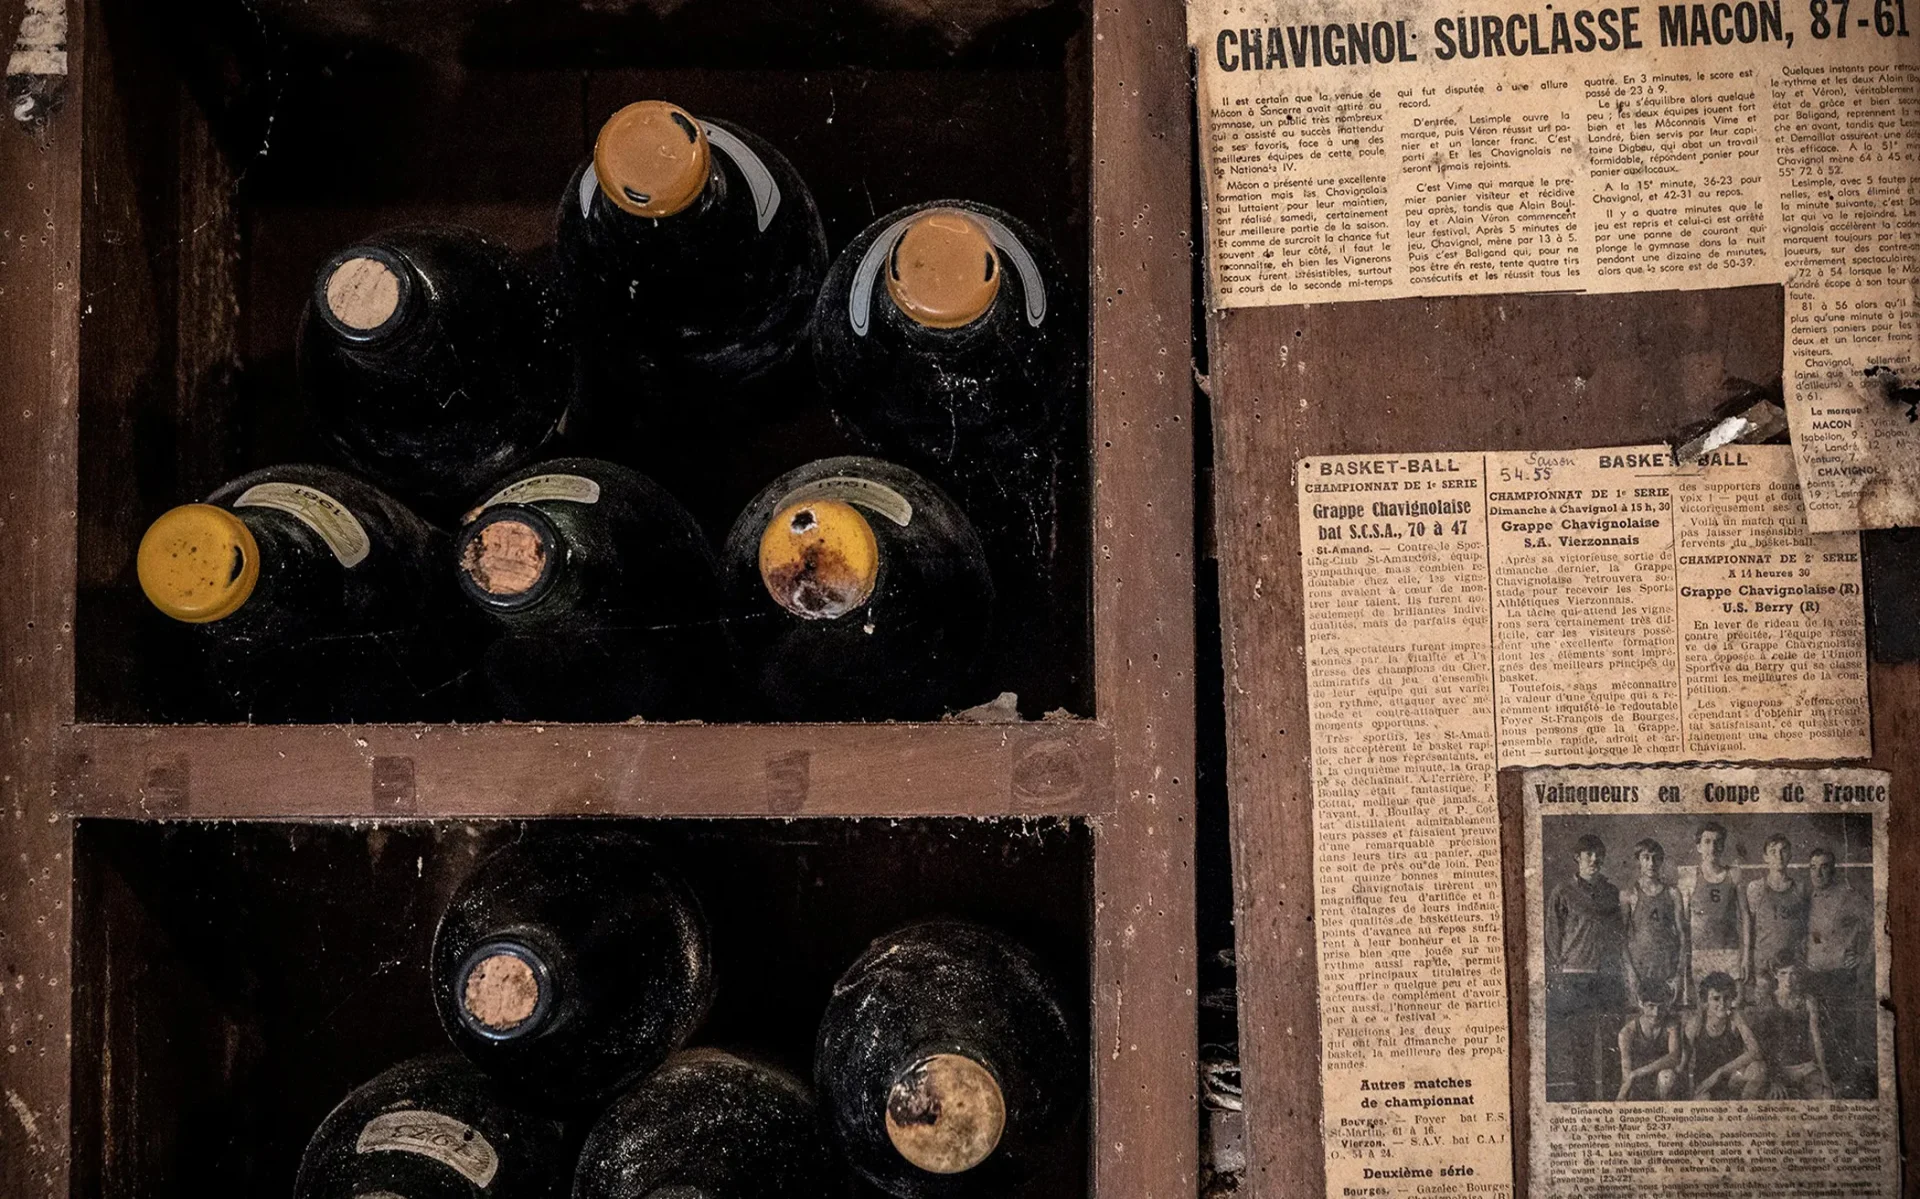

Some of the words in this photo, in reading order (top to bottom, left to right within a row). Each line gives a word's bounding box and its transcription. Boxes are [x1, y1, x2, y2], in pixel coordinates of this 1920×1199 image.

[1216, 20, 1417, 72] CHAVIGNOL
[1434, 5, 1643, 61] SURCLASSE
[1659, 0, 1794, 49] MACON,
[1624, 75, 1635, 84] En
[1641, 74, 1647, 83] 3
[1653, 73, 1692, 82] minutes,
[1697, 71, 1705, 80] le
[1710, 72, 1734, 80] score
[1740, 69, 1753, 78] est
[1782, 65, 1824, 76] Quelques
[1829, 65, 1864, 73] instants
[1869, 65, 1889, 73] pour
[1236, 97, 1249, 105] est
[1255, 93, 1288, 104] certain
[1295, 95, 1312, 103] que
[1319, 92, 1328, 100] la
[1335, 90, 1363, 100] venue
[1369, 89, 1381, 98] de
[1586, 88, 1610, 99] passé
[1615, 87, 1626, 96] de
[1630, 86, 1643, 95] 23
[1648, 85, 1653, 94] à
[1658, 85, 1668, 93] 9.
[1227, 181, 1259, 190] Mâcon
[1274, 178, 1313, 189] présenté
[1338, 175, 1386, 185] excellente
[1605, 183, 1613, 191] A
[1621, 182, 1629, 190] la
[1660, 180, 1696, 188] minute,
[1704, 176, 1733, 186] 36-23
[1741, 175, 1761, 185] pour
[1405, 196, 1426, 204] mier
[1436, 194, 1466, 204] panier
[1476, 192, 1510, 200] visiteur
[1519, 191, 1529, 199] et
[1539, 189, 1575, 198] récidive
[1593, 193, 1643, 204] Chavignol,
[1649, 193, 1658, 201] et
[1664, 190, 1692, 199] 42-31
[1716, 189, 1743, 198] repos.
[1216, 205, 1230, 215] qui
[1239, 204, 1279, 212] luttaient
[1287, 202, 1308, 211] pour
[1316, 200, 1335, 208] leur
[1343, 198, 1387, 207] maintien,
[1217, 217, 1231, 225] ont
[1241, 214, 1271, 223] réalisé
[1281, 212, 1317, 222] samedi,
[1326, 209, 1388, 219] certainement
[1407, 230, 1425, 238] leur
[1432, 227, 1470, 237] festival.
[1476, 225, 1503, 235] Après
[1510, 225, 1515, 233] 5
[1523, 224, 1559, 232] minutes
[1566, 223, 1577, 231] de
[1597, 255, 1635, 265] pendant
[1667, 251, 1701, 260] dizaine
[1708, 250, 1720, 258] de
[1726, 248, 1766, 256] minutes,
[1813, 420, 1852, 430] MACON
[1320, 459, 1460, 475] BASKET-BALL
[1305, 482, 1399, 493] CHAMPIONNAT
[1404, 481, 1420, 490] DE
[1442, 479, 1477, 488] SERIE
[1489, 490, 1582, 501] CHAMPIONNAT
[1591, 489, 1608, 498] DE
[1634, 488, 1669, 497] SERIE
[1313, 503, 1364, 519] Grappe
[1372, 499, 1471, 517] Chavignolaise
[1490, 506, 1547, 515] Dimanche
[1559, 503, 1617, 515] Chavignol
[1621, 503, 1628, 512] à
[1631, 503, 1642, 512] 15
[1658, 502, 1670, 511] 30
[1319, 525, 1342, 540] bat
[1350, 523, 1402, 539] S.C.S.A.,
[1408, 522, 1425, 537] 70
[1434, 521, 1443, 536] à
[1451, 520, 1467, 535] 47
[1501, 521, 1553, 533] Grappe
[1561, 518, 1660, 531] Chavignolaise
[1524, 537, 1551, 548] S.A.
[1558, 535, 1639, 547] Vierzonnais
[1679, 555, 1772, 565] CHAMPIONNAT
[1780, 554, 1796, 563] DE
[1823, 553, 1857, 562] SERIE
[1755, 569, 1793, 578] heures
[1799, 568, 1810, 577] 30
[1680, 586, 1731, 600] Grappe
[1739, 583, 1836, 598] Chavignolaise
[1839, 583, 1860, 596] (R)
[1723, 602, 1748, 613] U.S.
[1755, 602, 1793, 615] Berry
[1800, 601, 1820, 614] (R)
[1502, 727, 1527, 736] nous
[1536, 726, 1578, 736] pensons
[1587, 725, 1606, 735] que
[1535, 782, 1639, 805] Vainqueurs
[1658, 785, 1680, 803] en
[1703, 781, 1760, 805] Coupe
[1783, 781, 1805, 803] de
[1823, 781, 1885, 802] France
[1360, 1079, 1405, 1091] Autres
[1414, 1077, 1472, 1089] matches
[1361, 1097, 1378, 1108] de
[1385, 1095, 1474, 1109] championnat
[1460, 1114, 1477, 1123] bat
[1363, 1167, 1433, 1179] Deuxième
[1440, 1165, 1474, 1177] série
